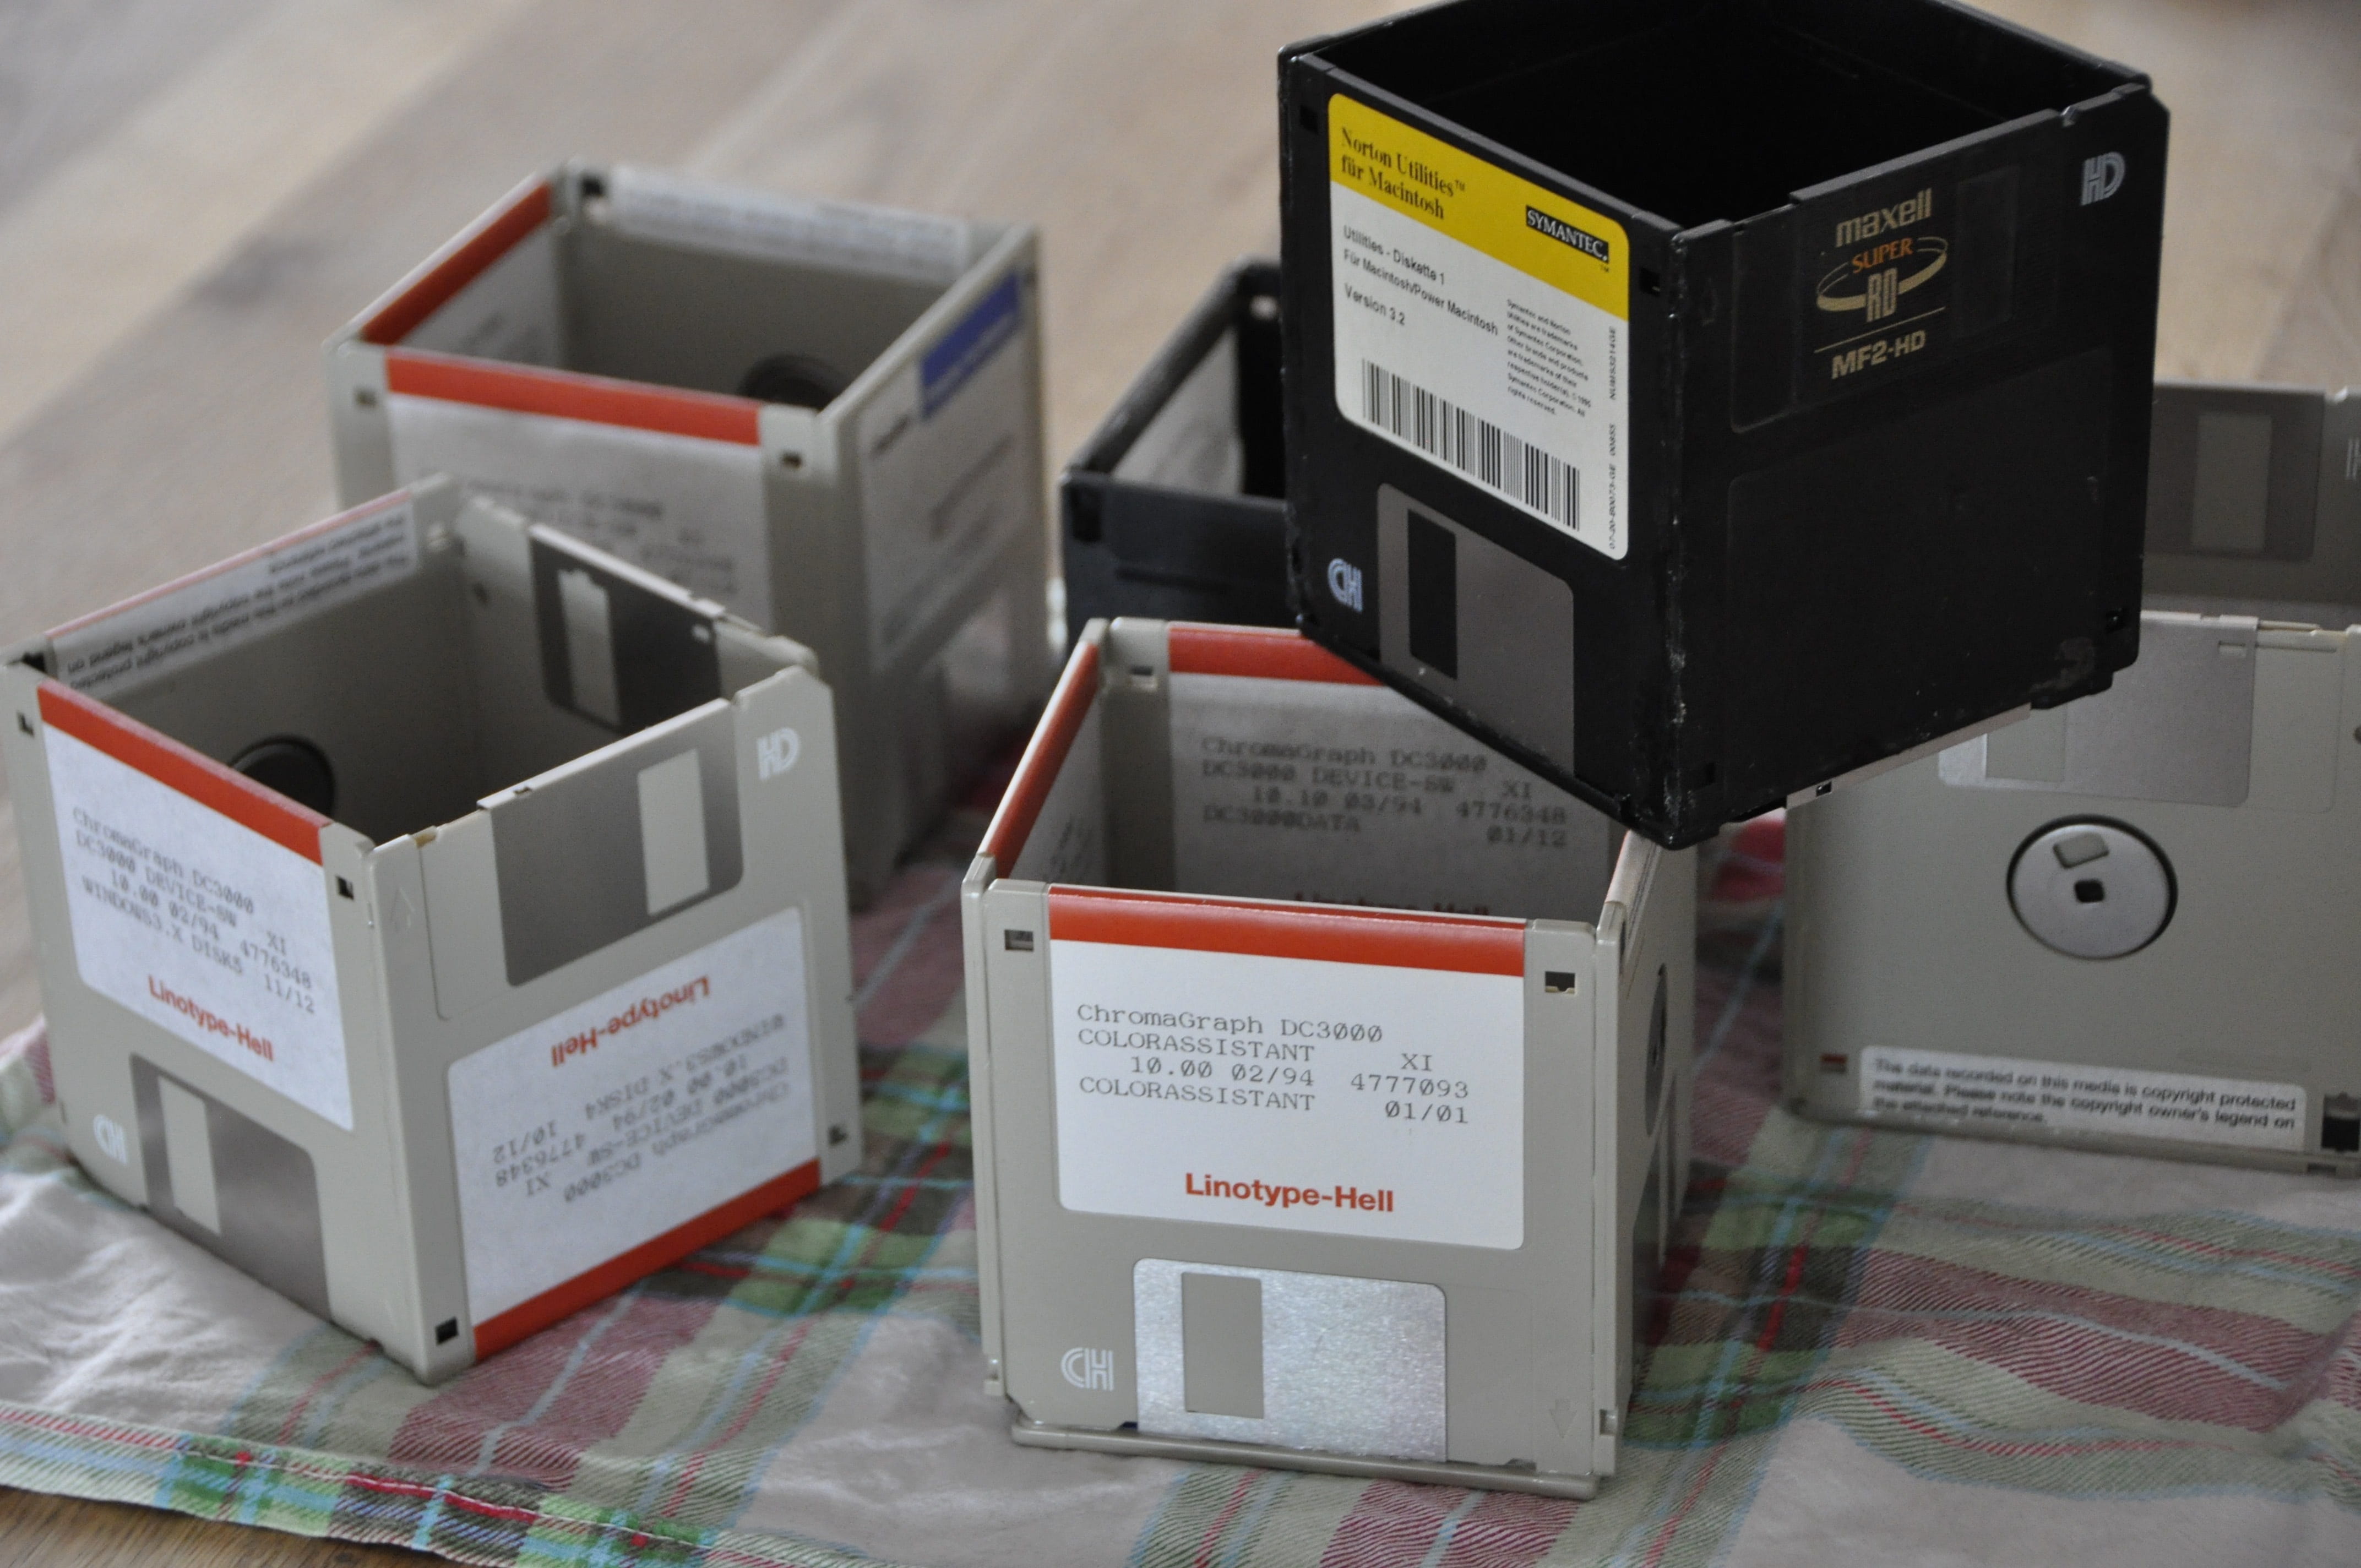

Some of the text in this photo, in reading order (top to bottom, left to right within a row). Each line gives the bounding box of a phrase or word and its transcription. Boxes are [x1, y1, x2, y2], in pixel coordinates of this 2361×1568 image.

[1341, 127, 1392, 168] Norton
[1341, 154, 1444, 219] für Macintosh
[2081, 151, 2125, 206] HD
[1836, 188, 1933, 248] maxell
[1343, 225, 1384, 255] Utilities
[1393, 248, 1437, 280] Diskette
[1439, 273, 1445, 285] 1
[1852, 237, 1913, 274] SUPER
[1343, 249, 1499, 335] Für Macintosh/Power Macintosh
[1345, 282, 1406, 325] Version 3.2
[1831, 330, 1925, 379] MF2-HD
[756, 726, 799, 780] HD
[73, 807, 254, 914] ChromaGraph DC3000
[265, 973, 315, 1014] 11/12
[149, 975, 273, 1061] Linotype-Hell
[552, 975, 710, 1067] Linotype-Hell
[1077, 1004, 1383, 1043] ChromaGraph DC3000
[1078, 1029, 1433, 1071] COLORASSISTANT XI
[1079, 1077, 1468, 1124] COLORASSISTANT 01/01
[1131, 1057, 1469, 1098] 10.00 02/94 4777093
[2142, 1085, 2216, 1104] copyright
[2219, 1093, 2295, 1111] protected
[2274, 1117, 2295, 1129] on
[1185, 1173, 1394, 1212] Linotype-Hell
